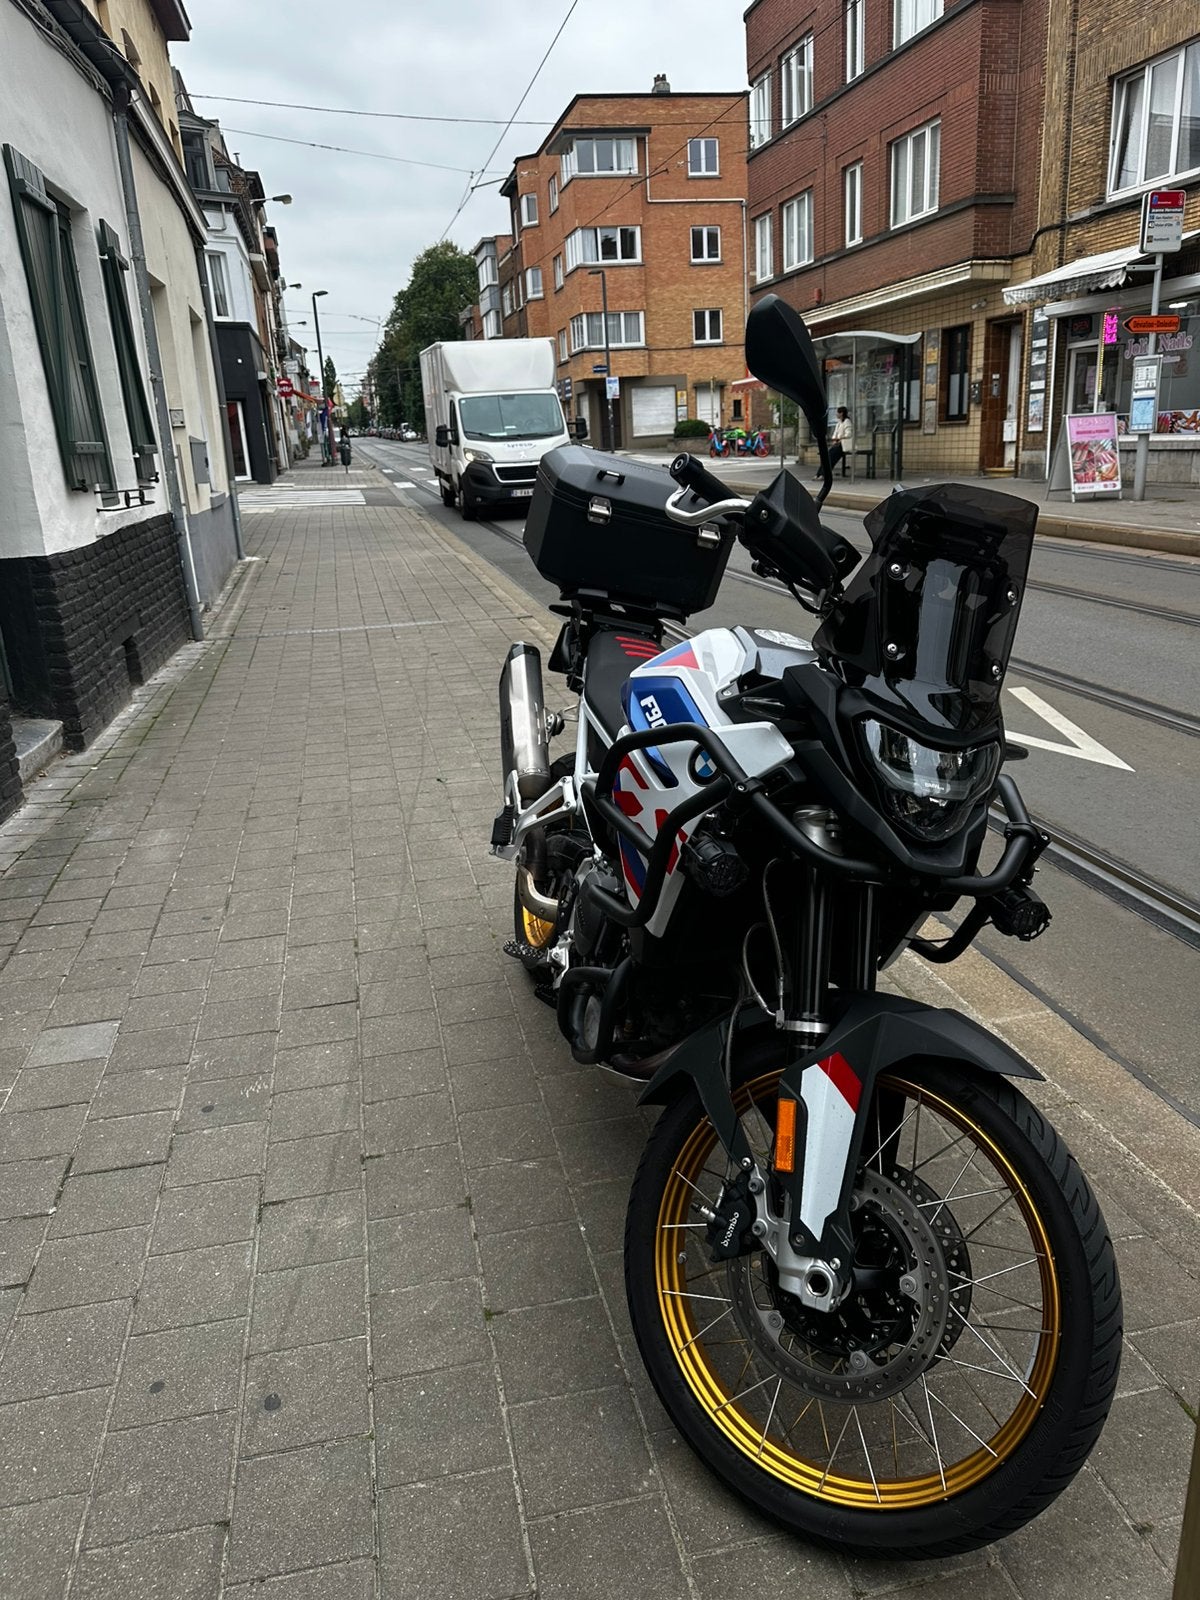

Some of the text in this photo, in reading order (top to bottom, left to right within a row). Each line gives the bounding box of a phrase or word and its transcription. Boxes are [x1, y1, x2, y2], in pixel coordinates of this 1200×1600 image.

[1124, 331, 1193, 360] Joli Nails
[721, 1212, 739, 1247] brembo
